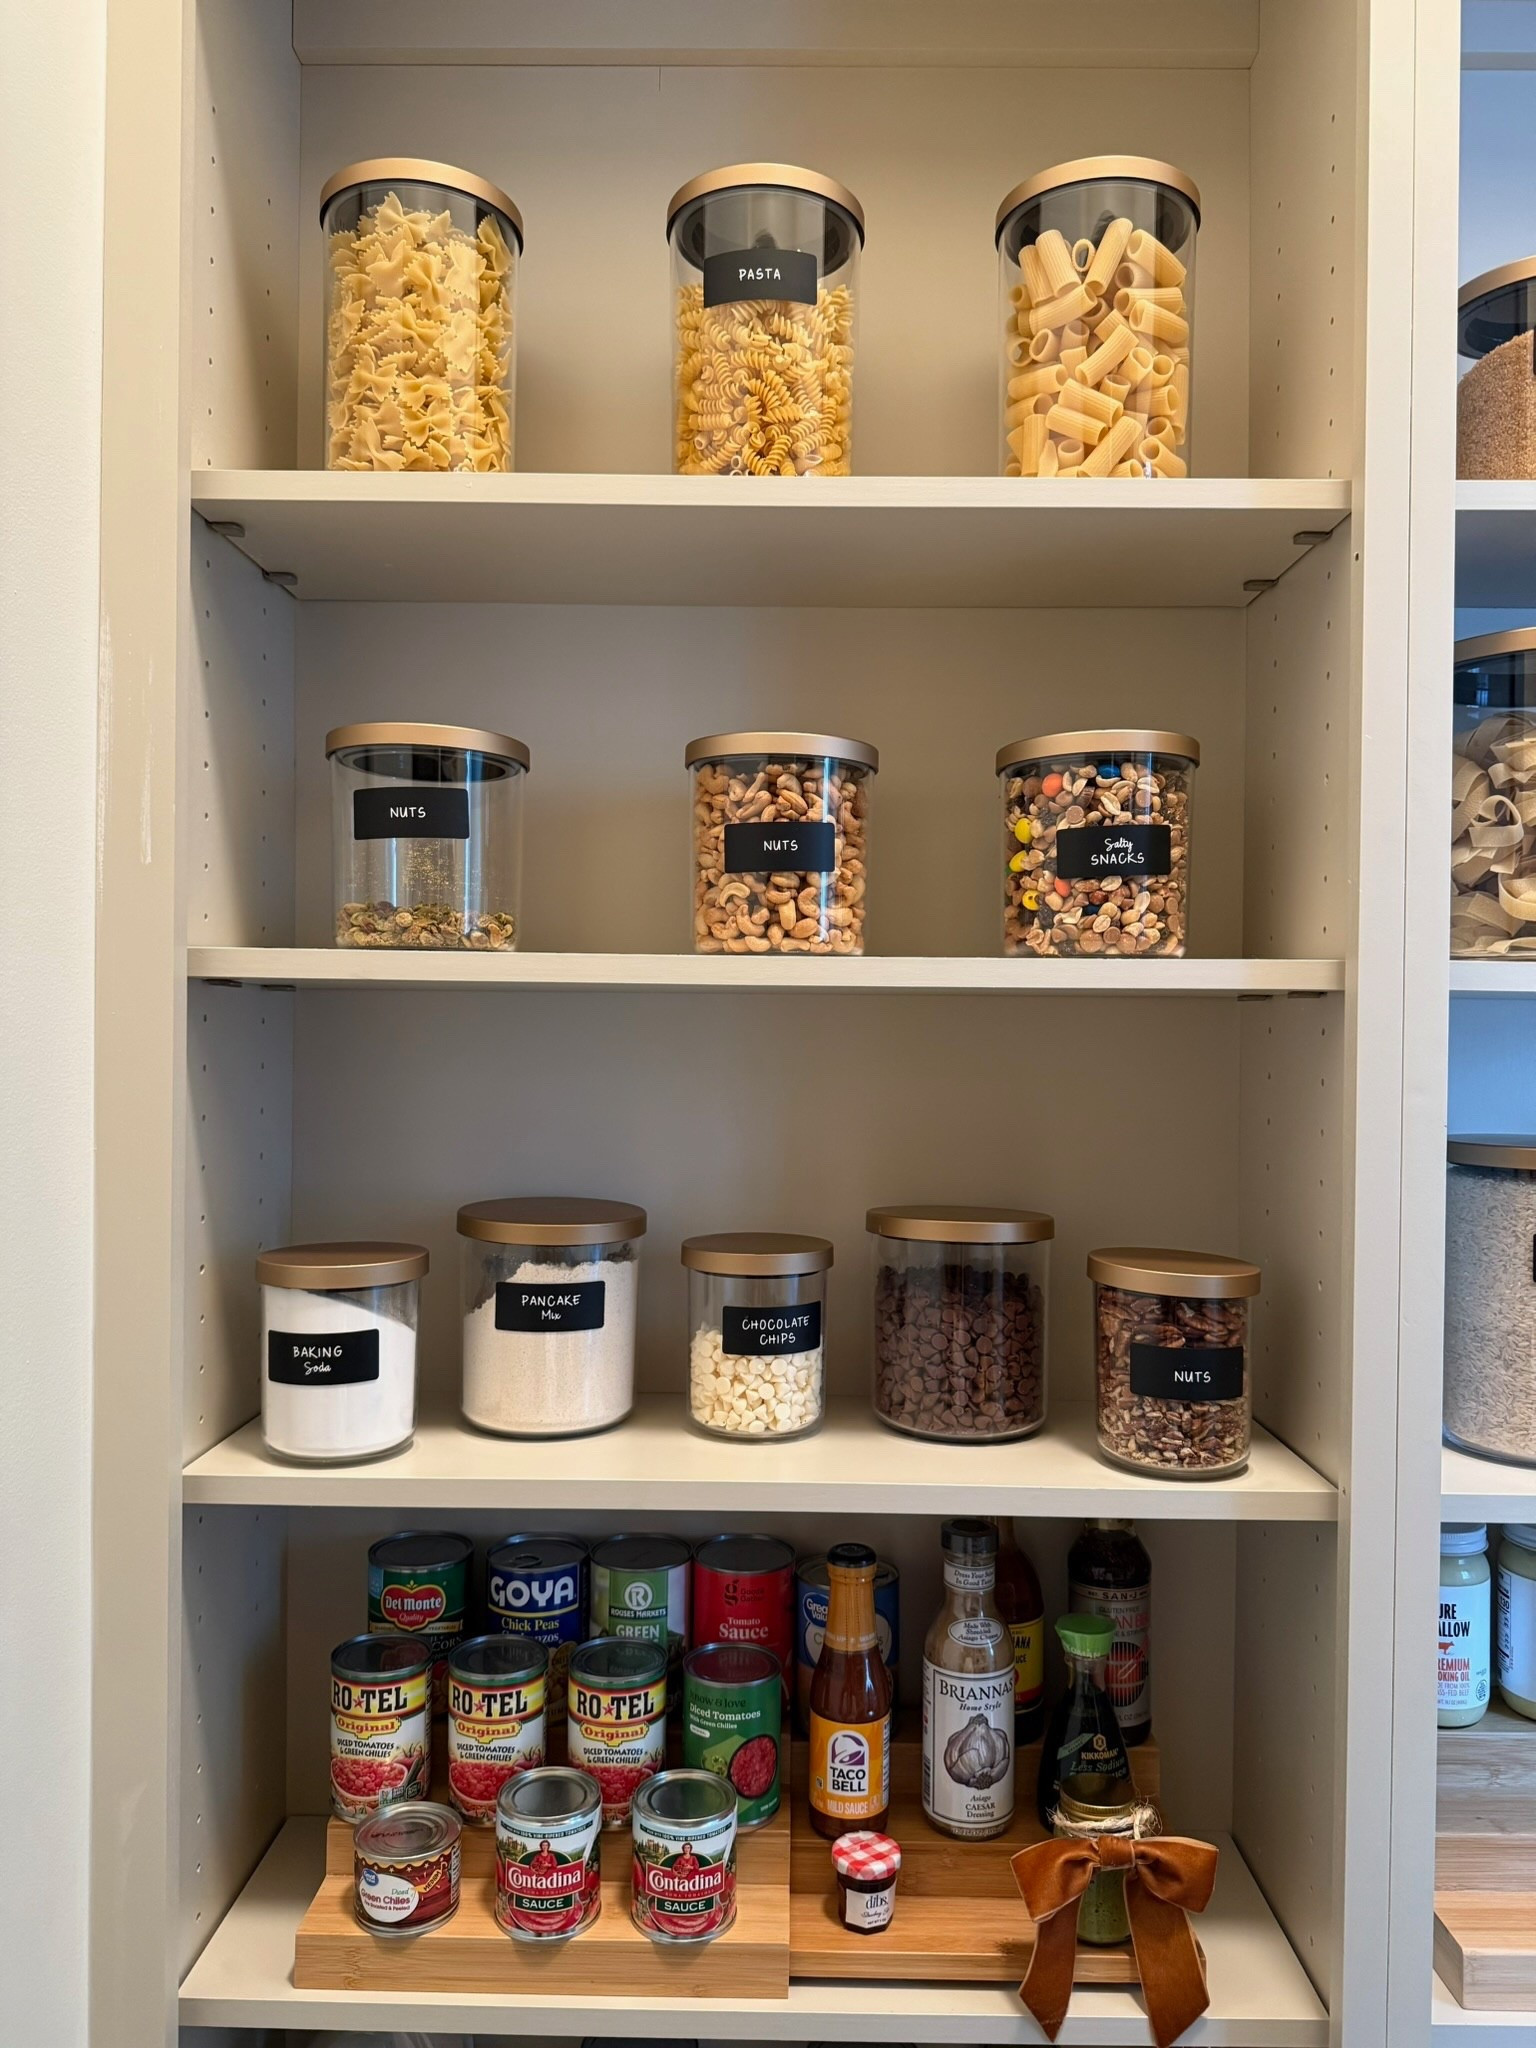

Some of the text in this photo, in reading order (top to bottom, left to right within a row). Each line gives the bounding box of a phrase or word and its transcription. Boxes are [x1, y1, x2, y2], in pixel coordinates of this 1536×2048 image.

[739, 268, 781, 281] PASTA
[390, 806, 426, 818] NUTS
[763, 840, 798, 851] NUTS
[1104, 837, 1133, 852] Salty
[1090, 852, 1145, 865] SNACKS
[521, 1294, 581, 1307] PANCAKE
[541, 1309, 561, 1320] Mix
[742, 1315, 810, 1330] CHOCOLATE
[759, 1332, 796, 1345] CHIPS
[293, 1345, 343, 1358] BAKING
[303, 1361, 331, 1375] Soda
[1174, 1370, 1211, 1383] NUTS
[490, 1576, 575, 1607] GOYA
[385, 1596, 442, 1611] Del Monte
[806, 1598, 828, 1614] Grea
[610, 1608, 666, 1618] ROUSES MARKETS
[811, 1611, 828, 1621] Valu
[1439, 1603, 1457, 1619] URE
[501, 1616, 560, 1631] Chick Peas
[727, 1617, 760, 1626] Tomato
[616, 1624, 660, 1639] GREEN
[719, 1622, 769, 1640] Sauce
[1439, 1621, 1470, 1638] LLOW
[1437, 1657, 1470, 1671] EMIUM
[1437, 1671, 1470, 1682] OKING OIL
[940, 1679, 1014, 1702] BRIANNAS
[724, 1698, 746, 1708] love
[959, 1701, 1002, 1712] Home Style
[690, 1702, 761, 1721] Diced Tomatoes
[337, 1716, 396, 1733] Original
[457, 1722, 516, 1737] Original
[584, 1726, 644, 1740] Original
[354, 1740, 395, 1750] TOMATOES
[475, 1744, 515, 1753] TOMATOES
[1081, 1748, 1118, 1760] KIKKOMAN
[830, 1766, 866, 1780] TACO
[1070, 1761, 1093, 1772] Less
[832, 1780, 866, 1792] BELL
[970, 1794, 992, 1803] Asiago
[844, 1801, 869, 1815] SAUCE
[965, 1802, 996, 1811] CAESAR
[966, 1810, 995, 1818] Dressing
[423, 1871, 442, 1891] MEDIUM
[508, 1866, 581, 1889] Contadina
[649, 1869, 721, 1892] Contadina
[361, 1888, 381, 1903] Green
[522, 1898, 564, 1909] SAUCE
[664, 1901, 706, 1912] SAUCE
